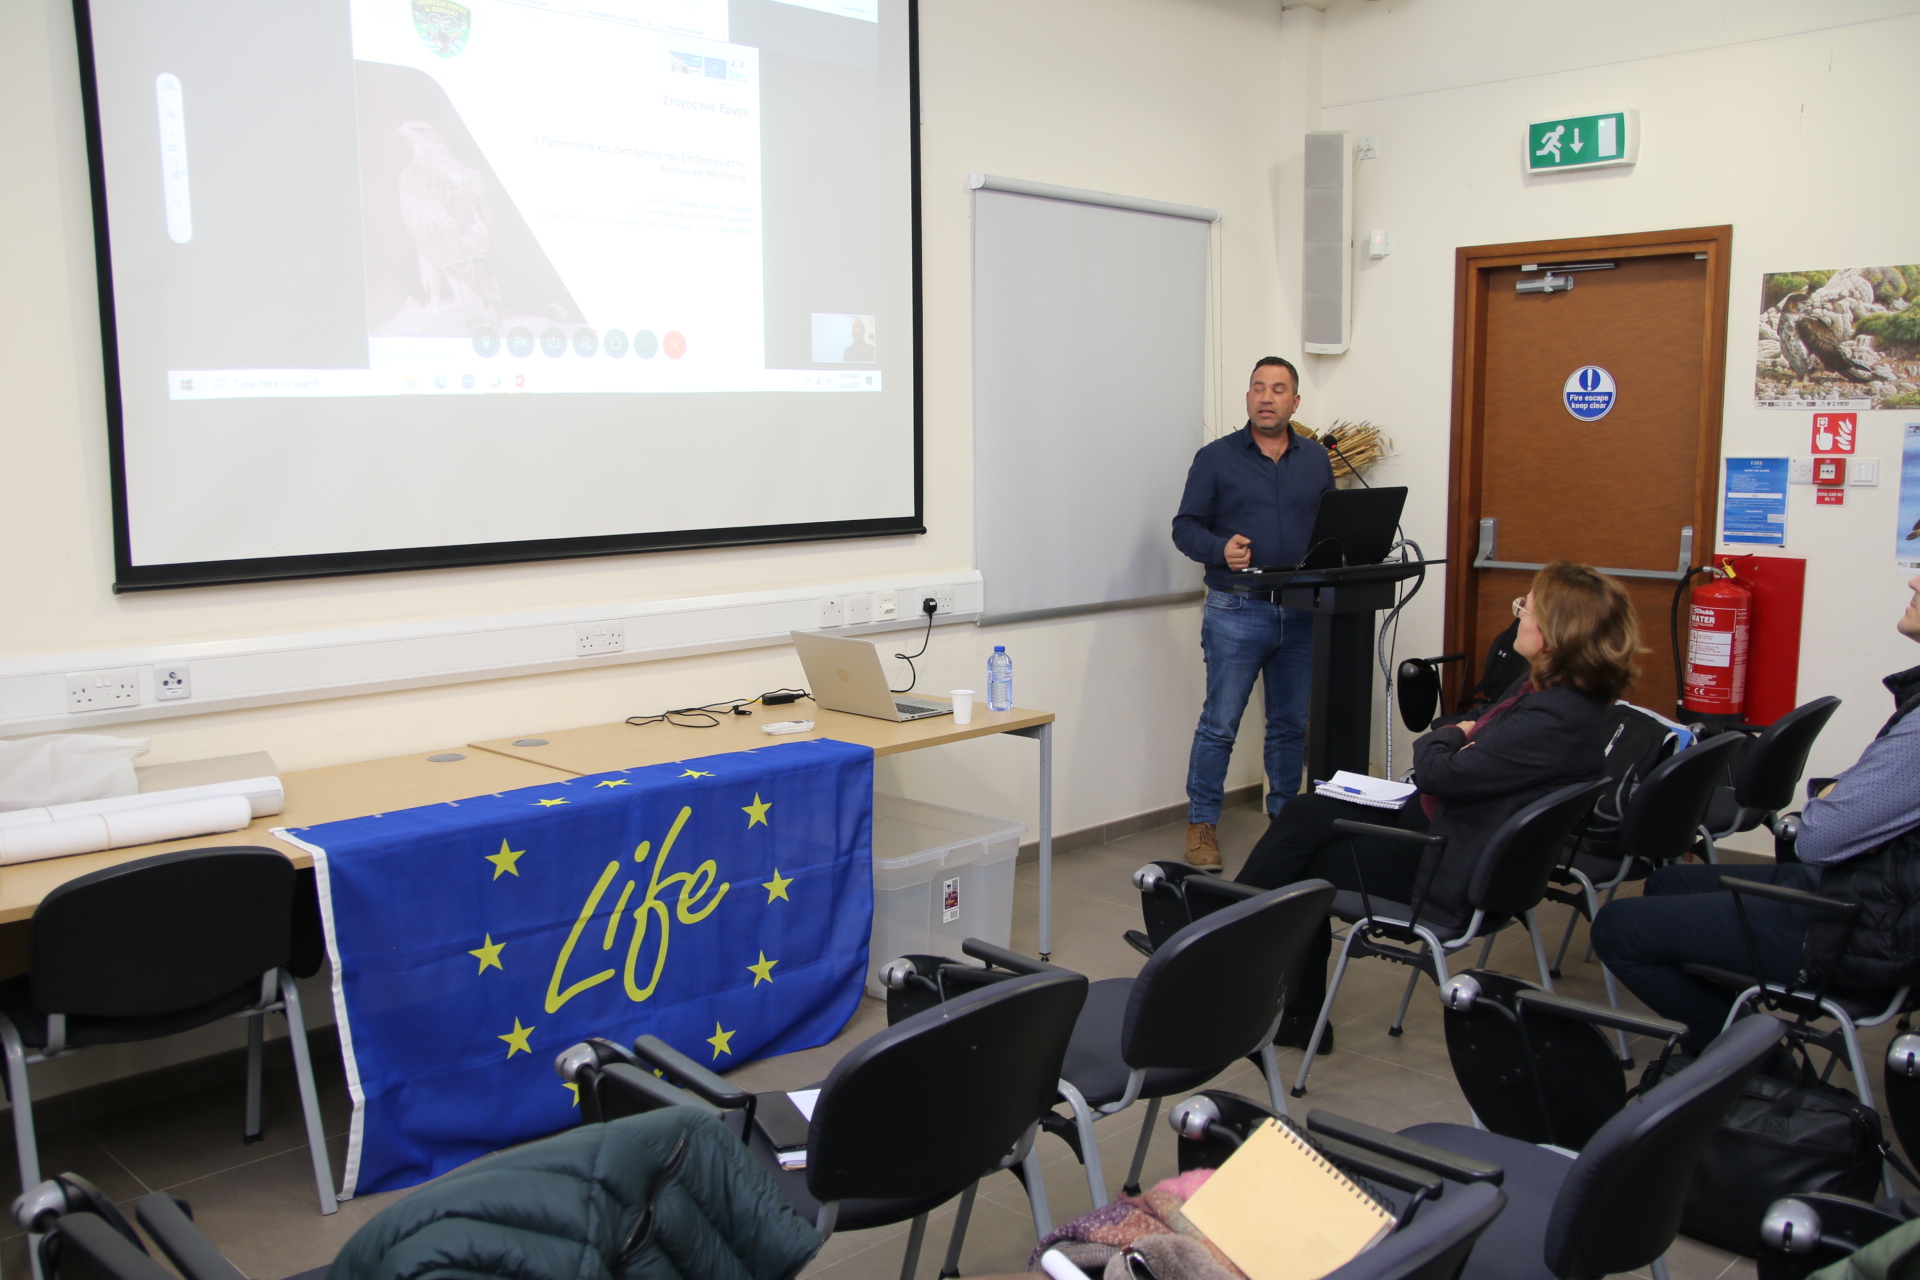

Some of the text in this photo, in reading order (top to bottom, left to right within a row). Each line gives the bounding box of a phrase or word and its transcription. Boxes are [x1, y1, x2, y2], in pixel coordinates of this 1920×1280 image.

[662, 94, 697, 112] Στόχος
[699, 102, 715, 112] του
[541, 136, 595, 152] Προστασία
[597, 144, 611, 153] και
[613, 145, 662, 160] Διατήρηση
[664, 152, 679, 161] του
[726, 159, 746, 169] στην
[660, 164, 746, 182] Ανατολική Μεσόγειο
[233, 379, 320, 390] Type here to search
[1571, 402, 1588, 410] keep
[1584, 395, 1609, 403] escape
[1696, 608, 1714, 616] Chubb
[544, 805, 730, 1014] Life
